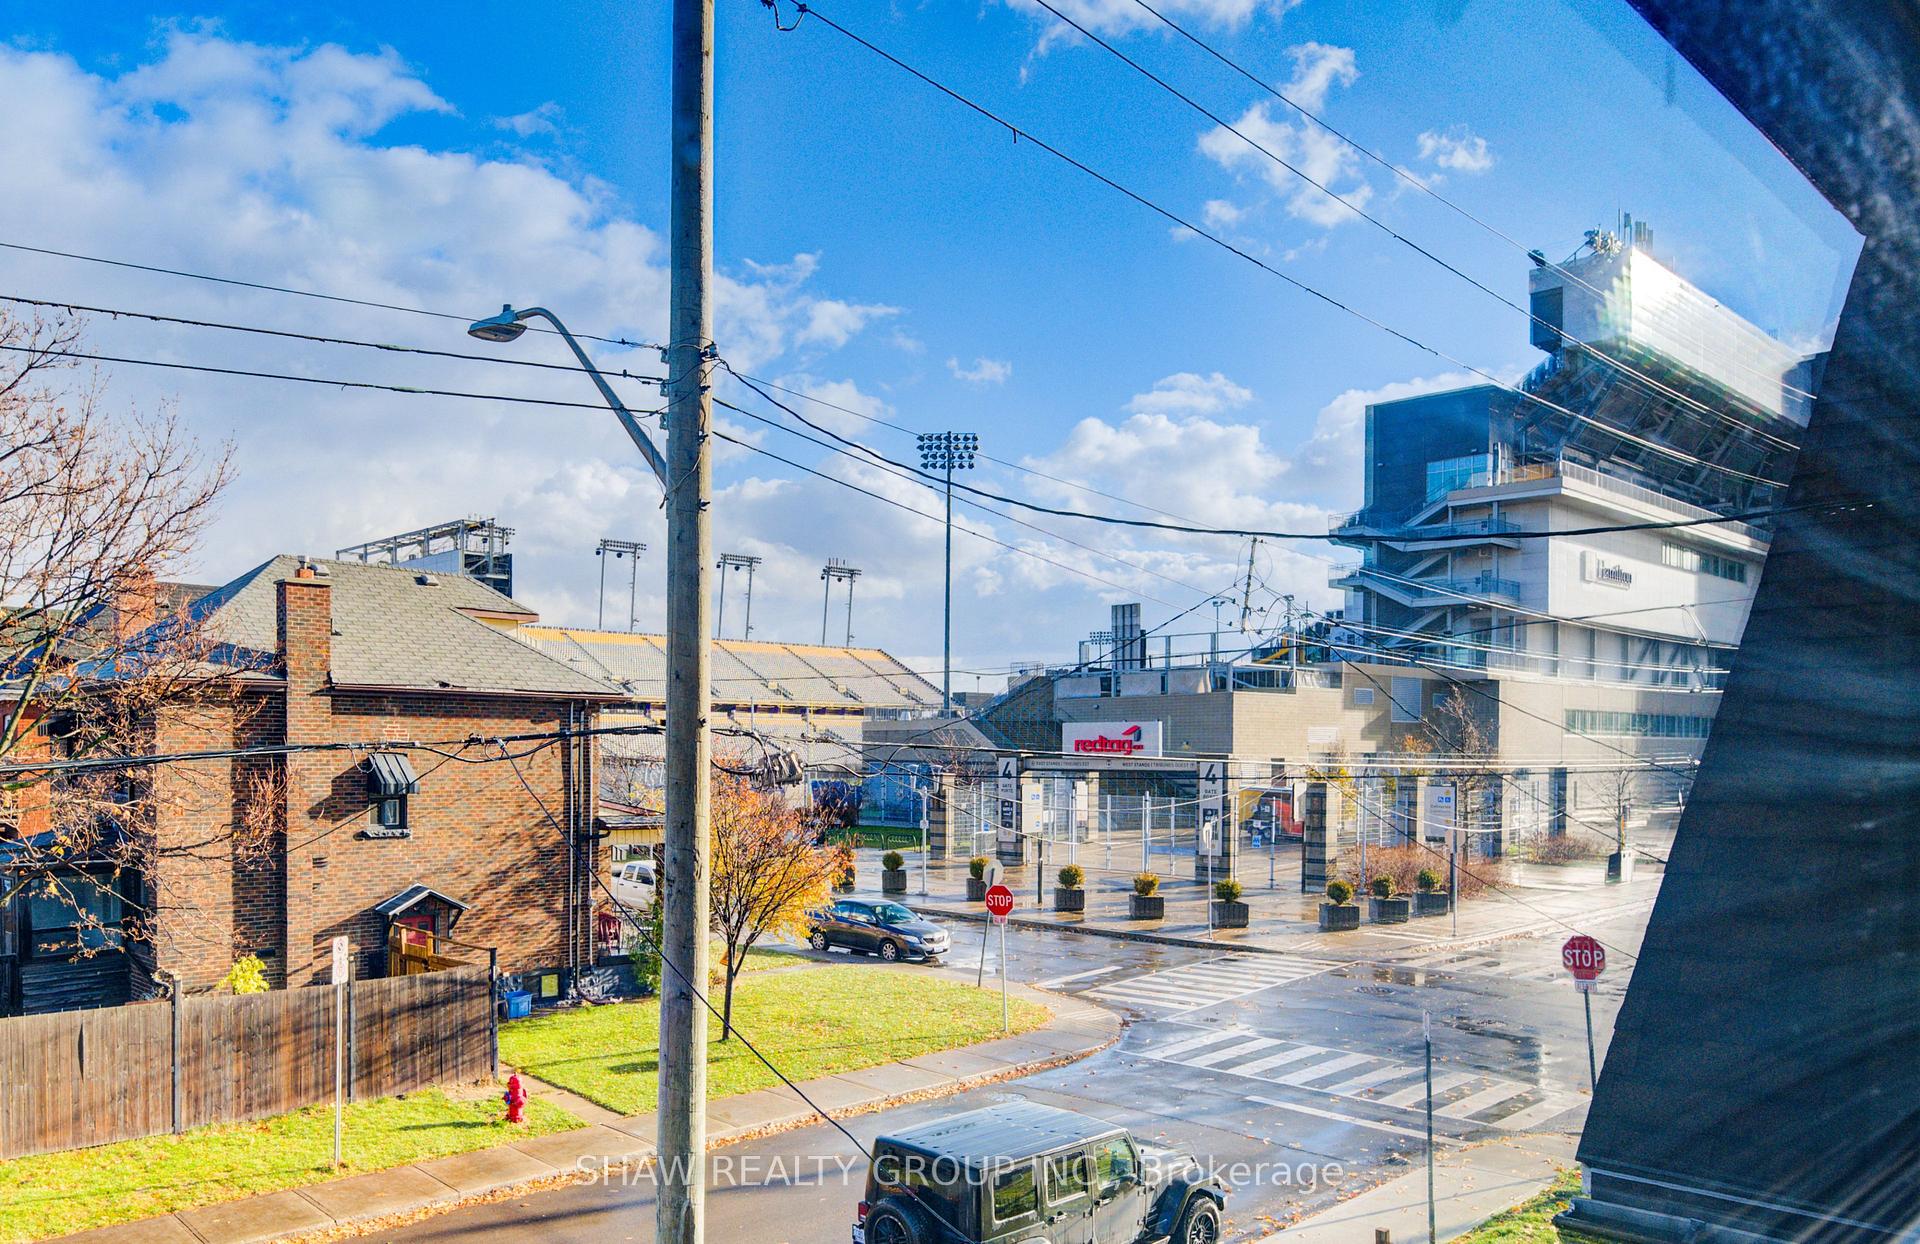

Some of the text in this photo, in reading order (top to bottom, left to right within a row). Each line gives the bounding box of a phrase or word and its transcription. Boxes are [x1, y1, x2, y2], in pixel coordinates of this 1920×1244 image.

[1003, 761, 1014, 779] 4
[1205, 764, 1217, 784] 4
[987, 894, 1012, 907] STOP
[1564, 949, 1603, 968] STOP
